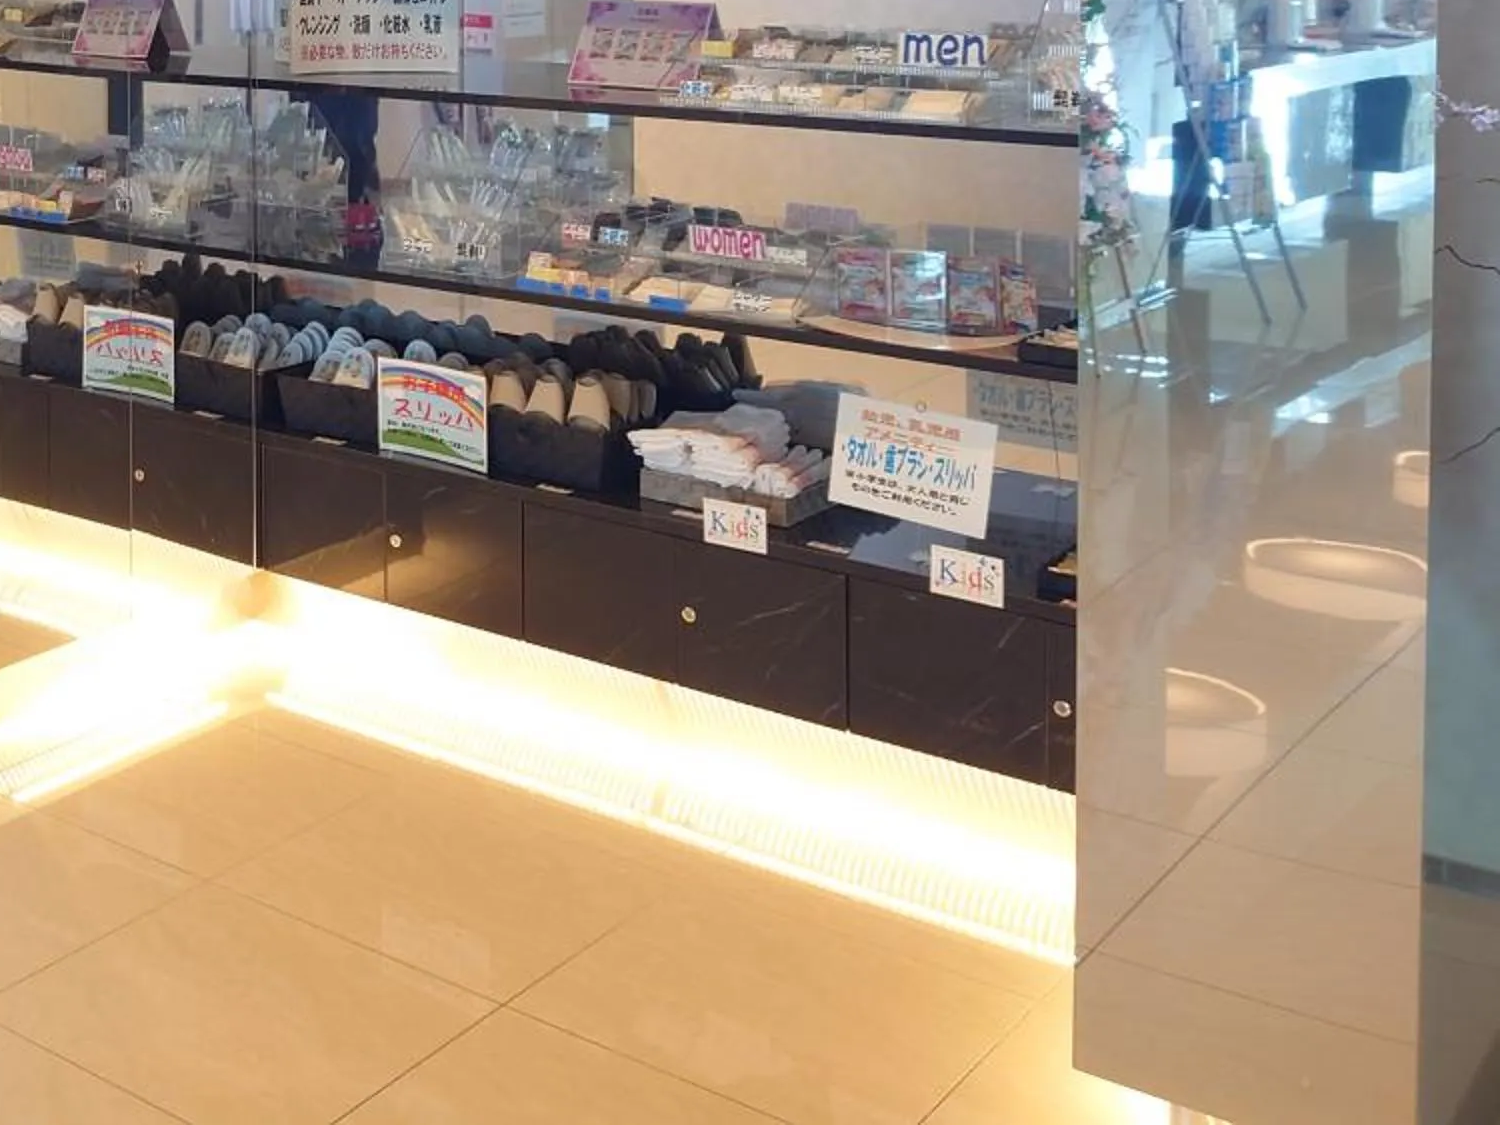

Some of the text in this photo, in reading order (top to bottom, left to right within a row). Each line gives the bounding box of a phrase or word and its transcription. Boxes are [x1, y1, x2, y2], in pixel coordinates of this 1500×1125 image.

[903, 32, 987, 66] men
[691, 225, 767, 260] women
[710, 510, 760, 540] Kids
[940, 558, 996, 591] Kids
